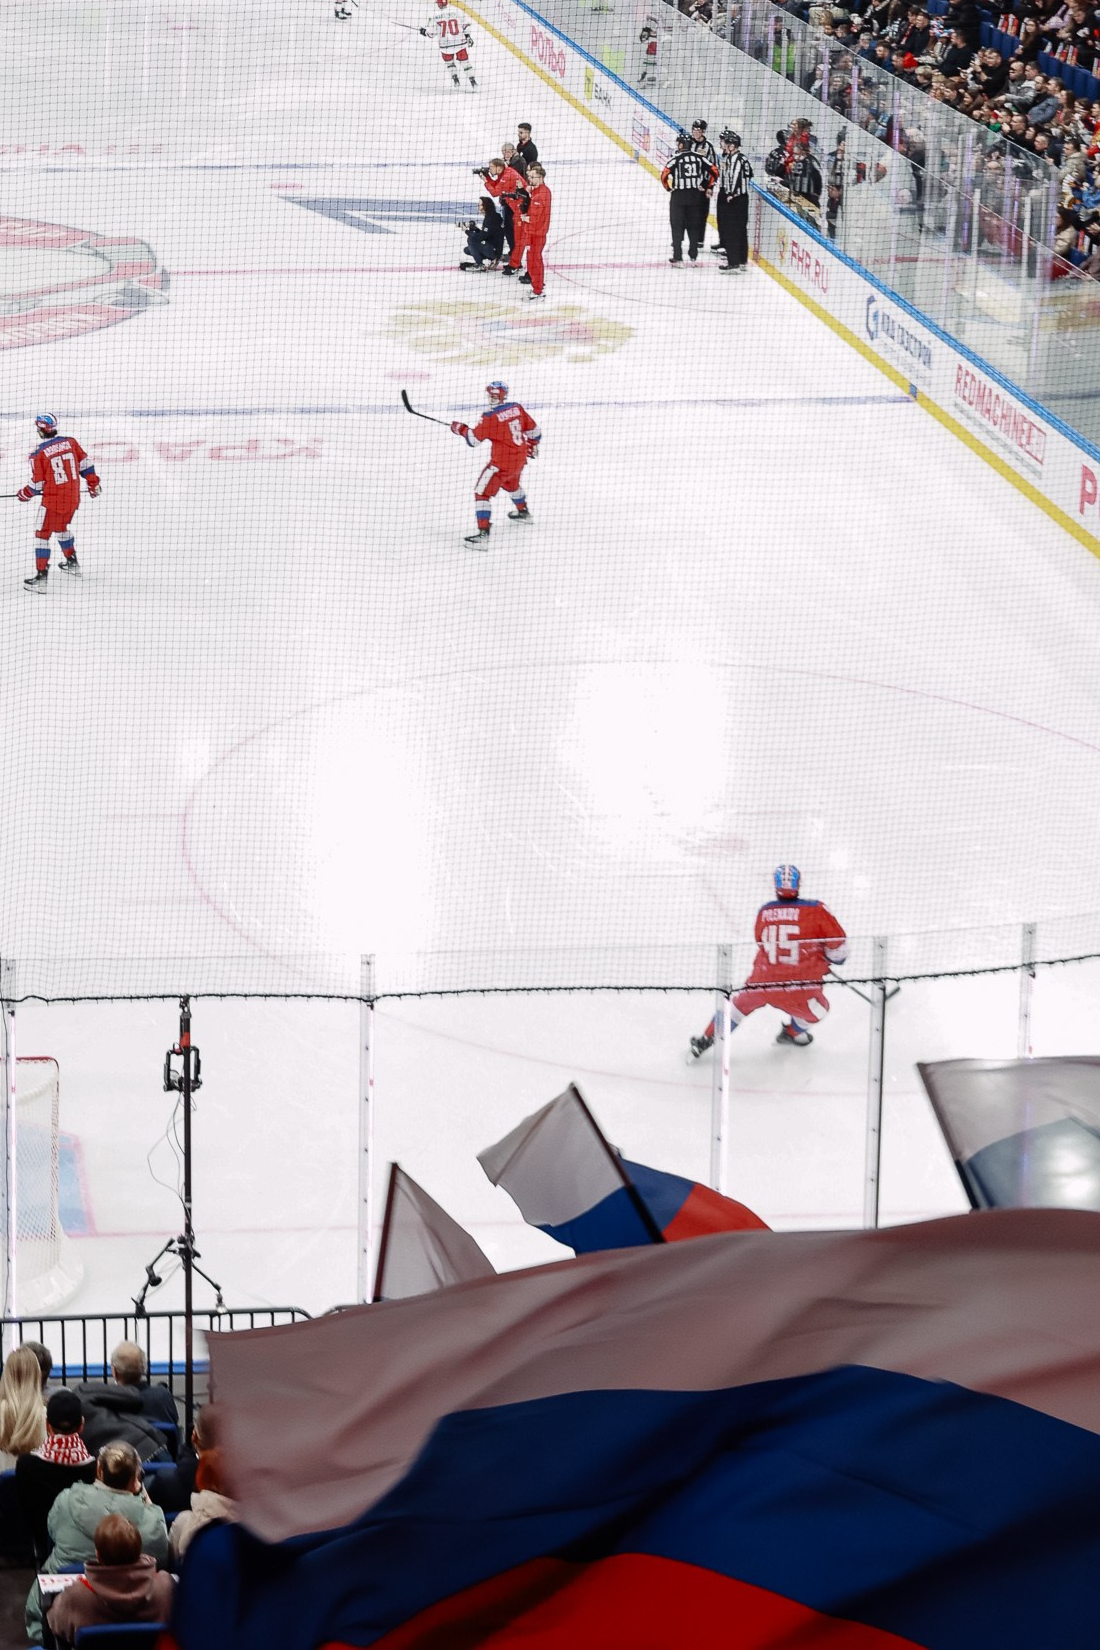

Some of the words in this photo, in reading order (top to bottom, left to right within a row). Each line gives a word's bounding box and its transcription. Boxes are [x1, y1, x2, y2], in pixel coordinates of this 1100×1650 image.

[437, 19, 459, 38] 70
[530, 24, 566, 78] РОЛЬФ
[684, 165, 698, 179] 31
[790, 239, 830, 294] FHR.RU
[50, 452, 78, 486] 87
[760, 924, 801, 967] 45
